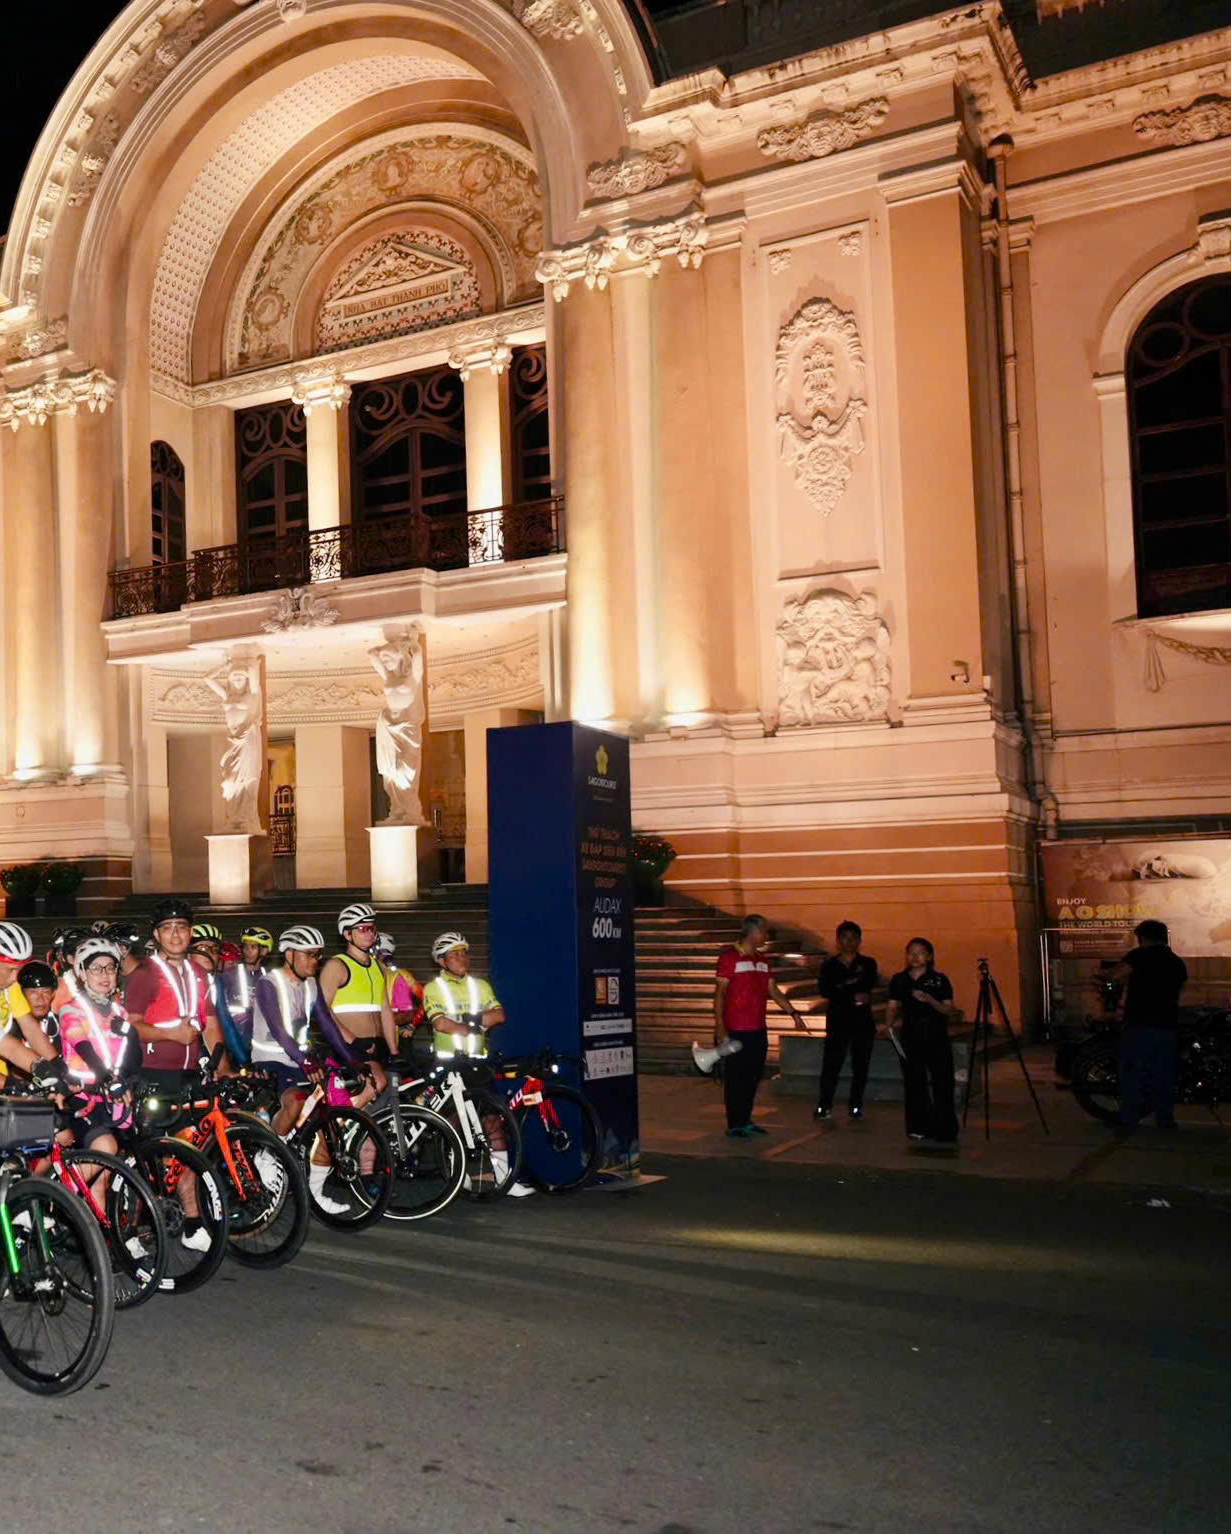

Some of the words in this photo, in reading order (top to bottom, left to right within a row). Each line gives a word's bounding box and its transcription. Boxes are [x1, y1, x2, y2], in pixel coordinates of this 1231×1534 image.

[594, 897, 622, 915] AUDAX
[1056, 897, 1087, 905] ENJOY
[592, 917, 612, 939] 600
